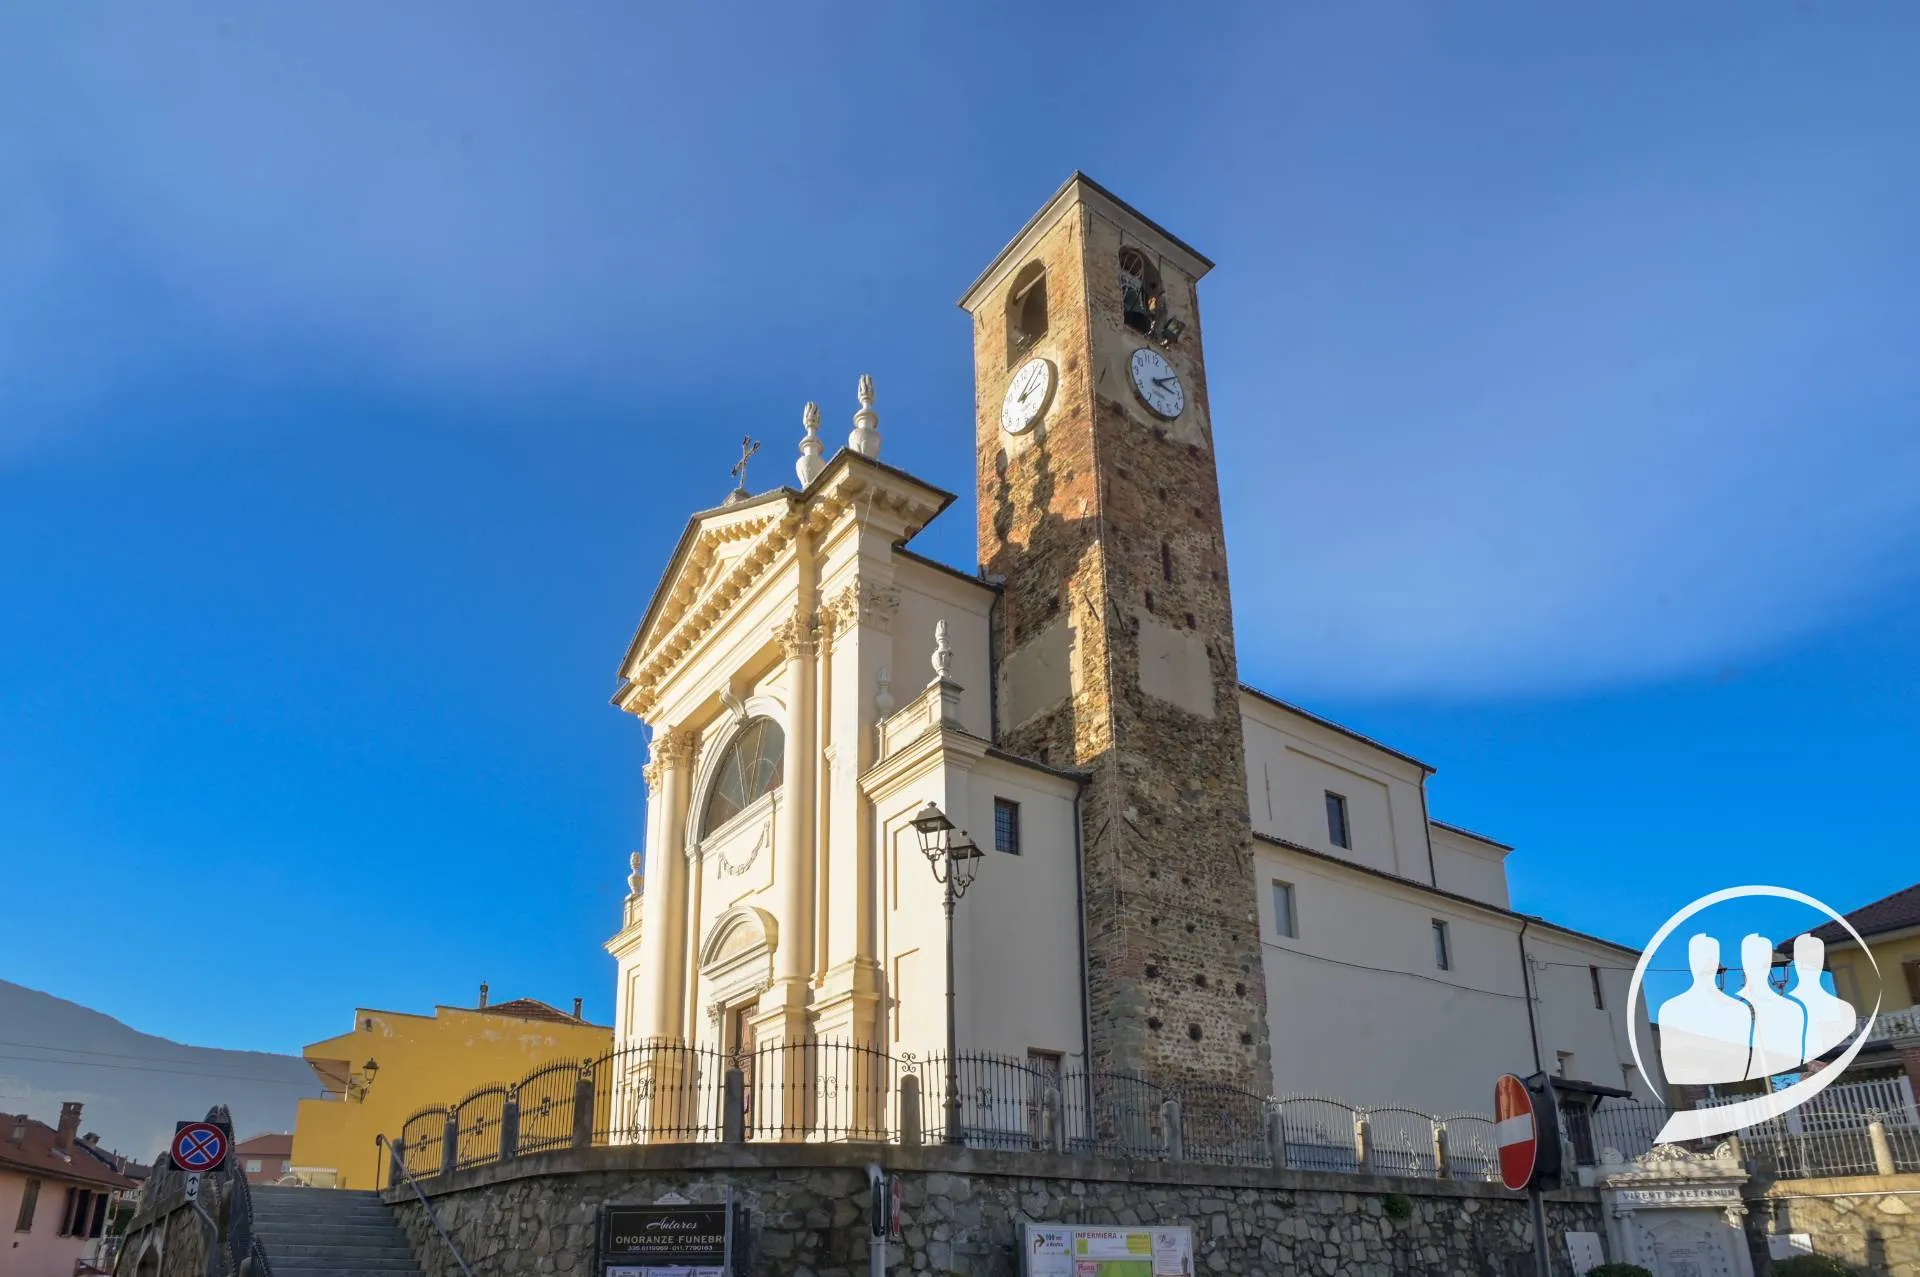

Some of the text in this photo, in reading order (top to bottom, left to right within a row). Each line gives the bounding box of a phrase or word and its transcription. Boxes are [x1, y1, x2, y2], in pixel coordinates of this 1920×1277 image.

[1152, 353, 1160, 368] 12
[646, 1216, 698, 1230] Antares
[615, 1235, 675, 1244] ONORANZE
